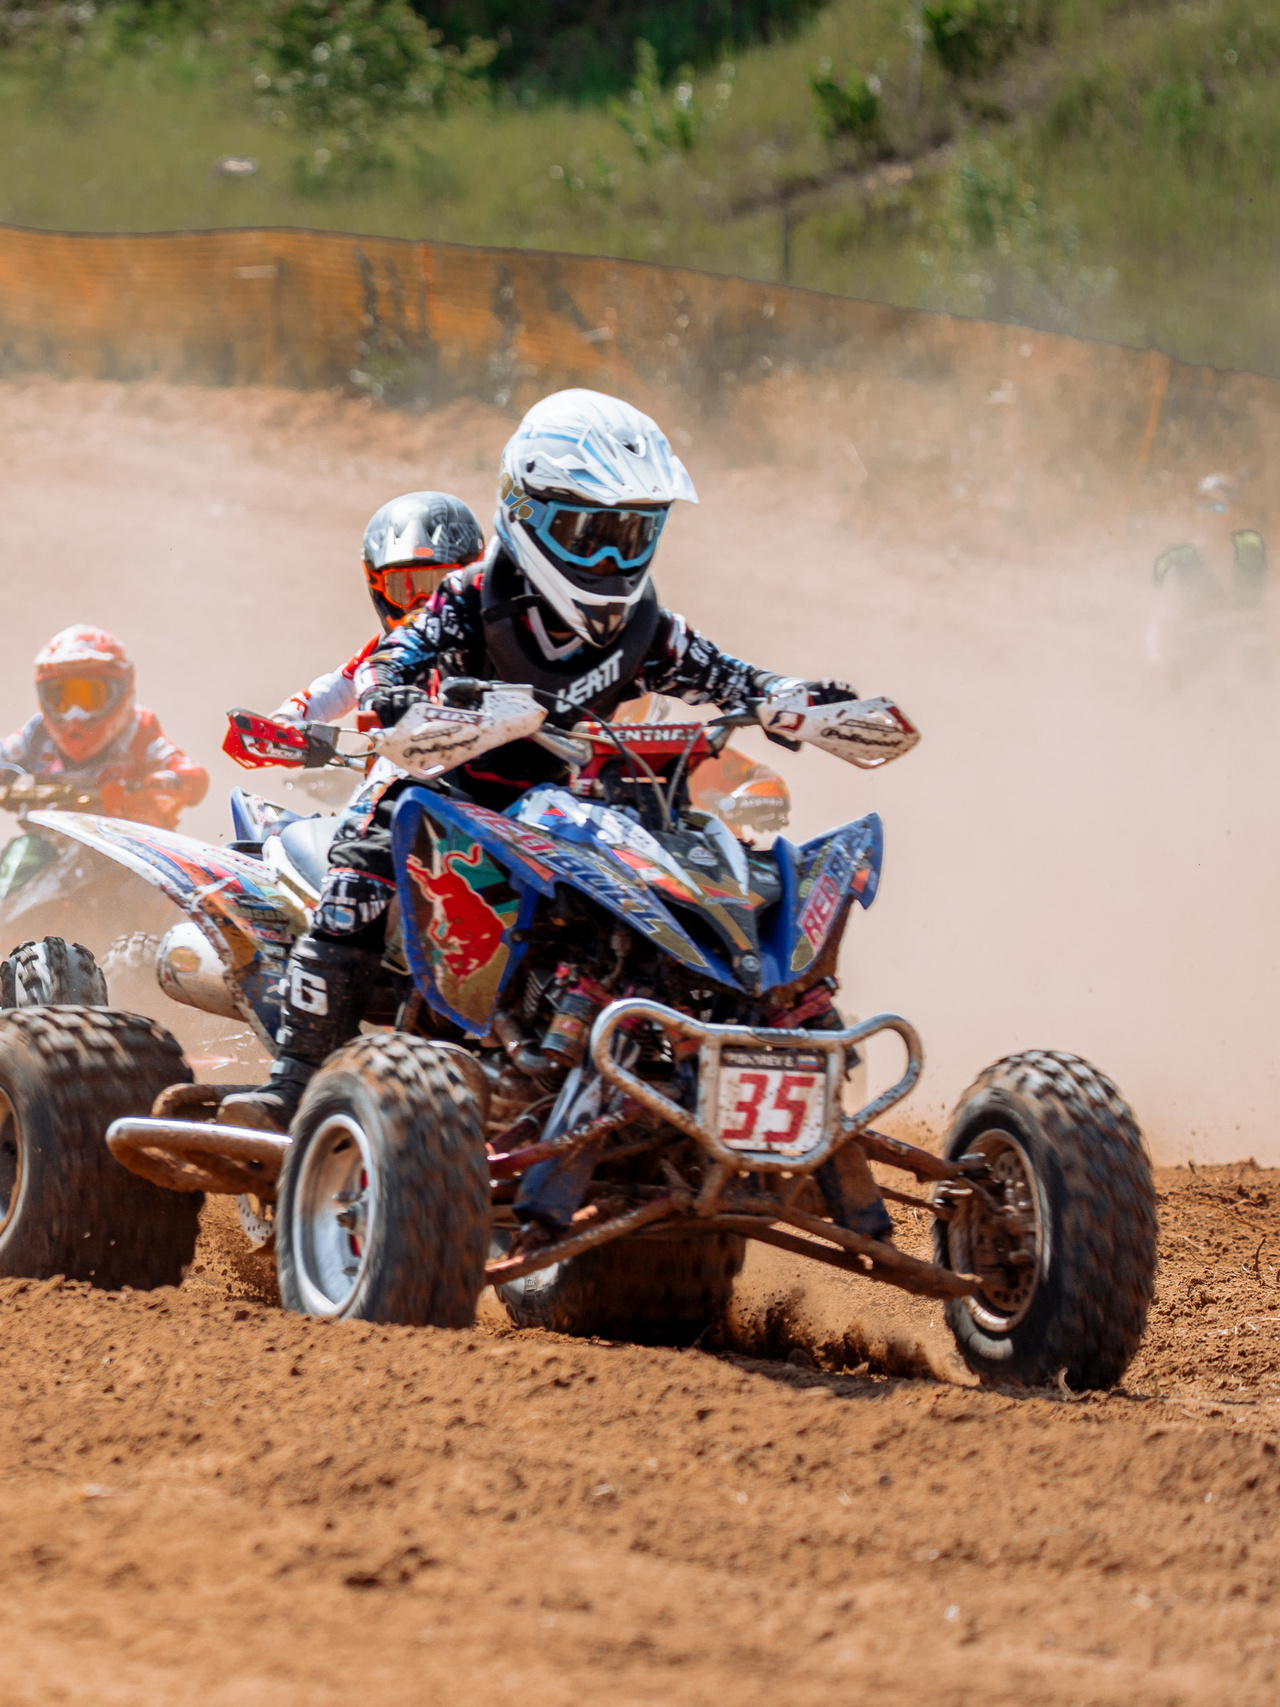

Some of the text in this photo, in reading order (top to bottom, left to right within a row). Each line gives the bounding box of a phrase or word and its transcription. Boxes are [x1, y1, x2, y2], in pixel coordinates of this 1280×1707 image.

[554, 648, 624, 714] LEATT
[801, 872, 841, 949] RED
[722, 1072, 817, 1143] 35
